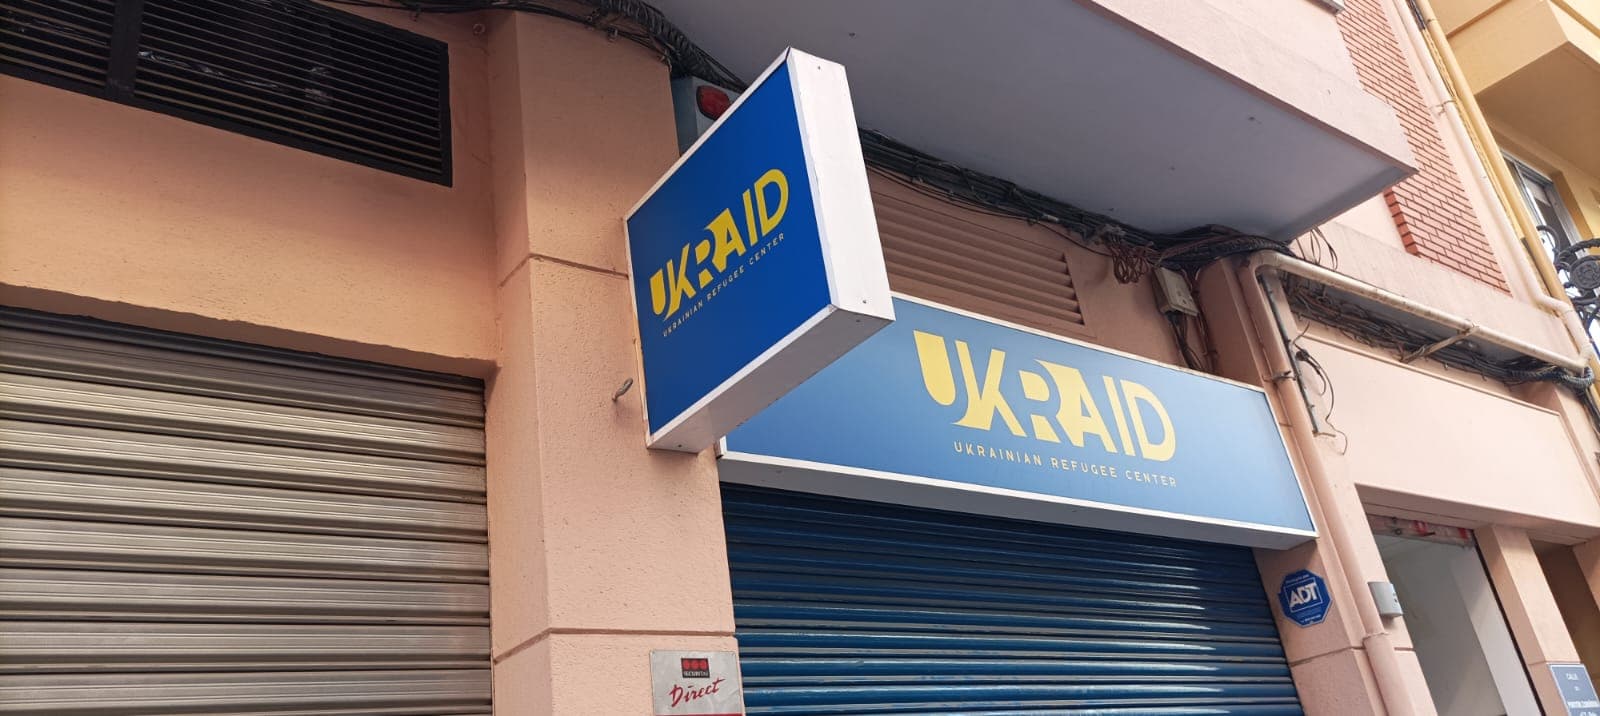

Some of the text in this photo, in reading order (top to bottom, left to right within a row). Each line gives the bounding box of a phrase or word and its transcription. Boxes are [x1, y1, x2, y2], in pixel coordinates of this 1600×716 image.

[650, 168, 789, 321] UKRAID
[663, 232, 785, 337] UKRAINIAN REFUGEE CENTER
[913, 330, 1176, 462] UKRAID
[954, 441, 1177, 488] UKRAINIAN REFUGEE CENTER
[1290, 582, 1318, 607] ADT
[669, 677, 726, 707] Direct
